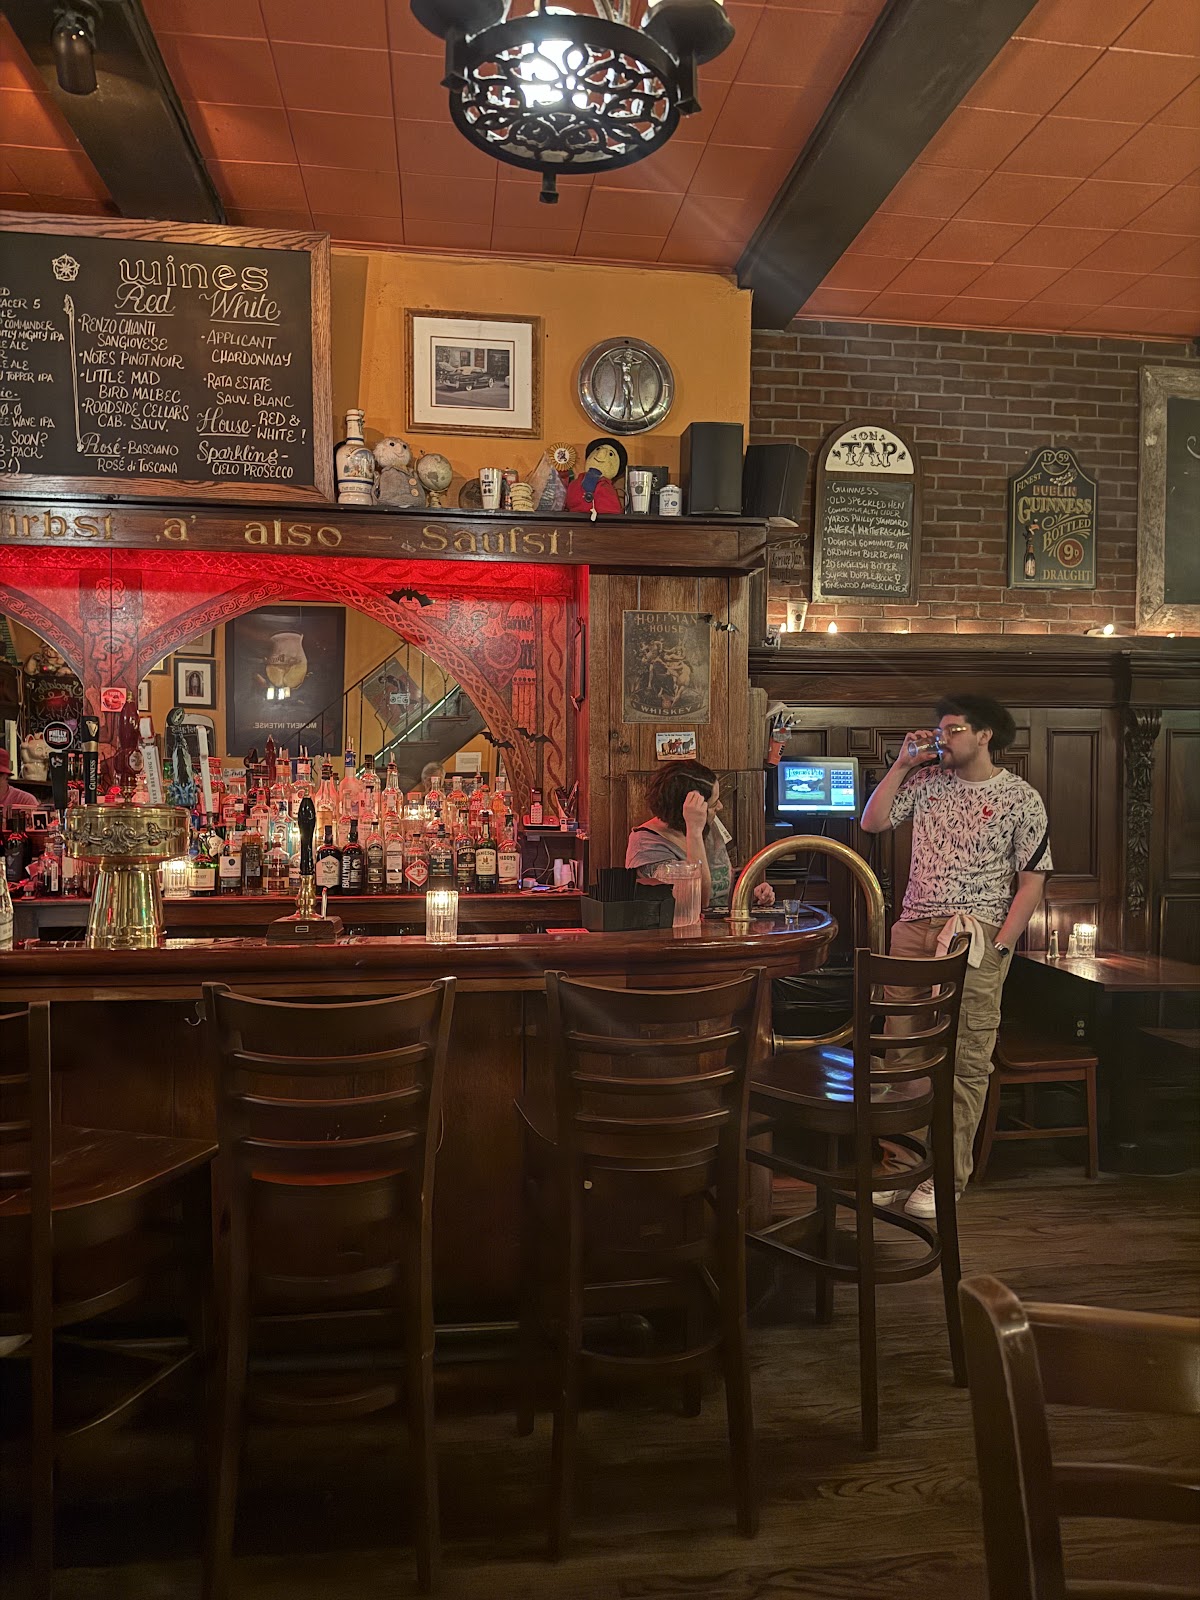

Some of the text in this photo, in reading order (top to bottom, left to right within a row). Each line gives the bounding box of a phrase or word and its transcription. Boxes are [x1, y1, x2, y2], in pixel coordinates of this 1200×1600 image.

[119, 254, 269, 292] wines
[0, 298, 40, 309] ACER 5
[114, 282, 176, 313] Red
[199, 290, 281, 320] White
[5, 319, 55, 330] COMMANDER
[81, 314, 156, 336] RENZO CHIANTI
[18, 330, 48, 342] MIGHTY
[50, 331, 64, 342] IPA
[98, 333, 168, 351] SANGIOVESE
[206, 329, 278, 350] APPLICANT
[10, 341, 28, 350] ALE
[10, 360, 29, 370] ALE
[83, 348, 184, 370] NOTES PINOT NOIR
[212, 349, 292, 366] CHARDONNAY
[6, 372, 34, 383] TOPPER
[38, 373, 54, 382] IPA
[86, 368, 160, 385] LITTLE MAD
[208, 372, 272, 392] RATA ESTATE
[98, 384, 181, 404] BIRD MALBEC
[216, 392, 294, 408] SAUV. BLANC
[84, 398, 190, 422] ROADSIDE CELLARS
[258, 410, 286, 426] RED
[289, 414, 300, 426] &
[12, 415, 36, 428] WAVE
[40, 416, 55, 428] IPA
[98, 414, 169, 432] CAB. SAUV.
[10, 430, 48, 447] SOON?
[858, 430, 878, 441] ON
[840, 442, 898, 468] TAP
[1043, 452, 1069, 462] 17 59
[138, 458, 178, 474] TOSCANA
[212, 462, 294, 478] CIELO PROSECCO
[832, 482, 879, 496] GUINNESS
[1016, 472, 1042, 494] FINEST
[1032, 485, 1078, 496] DUBLIN
[829, 496, 905, 510] OLD SPECKLED HEN
[1018, 496, 1093, 524] GUINNESS
[828, 506, 900, 518] COMMONWEALTH CIDER
[851, 514, 874, 526] PHILLY
[876, 516, 908, 528] STANDARD
[244, 518, 342, 547] also
[827, 524, 856, 537] AVERY
[1042, 518, 1092, 552] BOTTLED
[896, 542, 908, 550] IPA
[836, 561, 868, 570] ENGLISH
[870, 561, 898, 571] BITTER
[1042, 570, 1091, 580] DRAUGHT
[824, 580, 908, 592] TONEWOOD AMBER LAGER
[634, 613, 698, 626] HOFFMAN
[650, 624, 684, 634] HOUSE
[640, 706, 692, 715] WHISKEY
[342, 856, 350, 888] BALLYHOO
